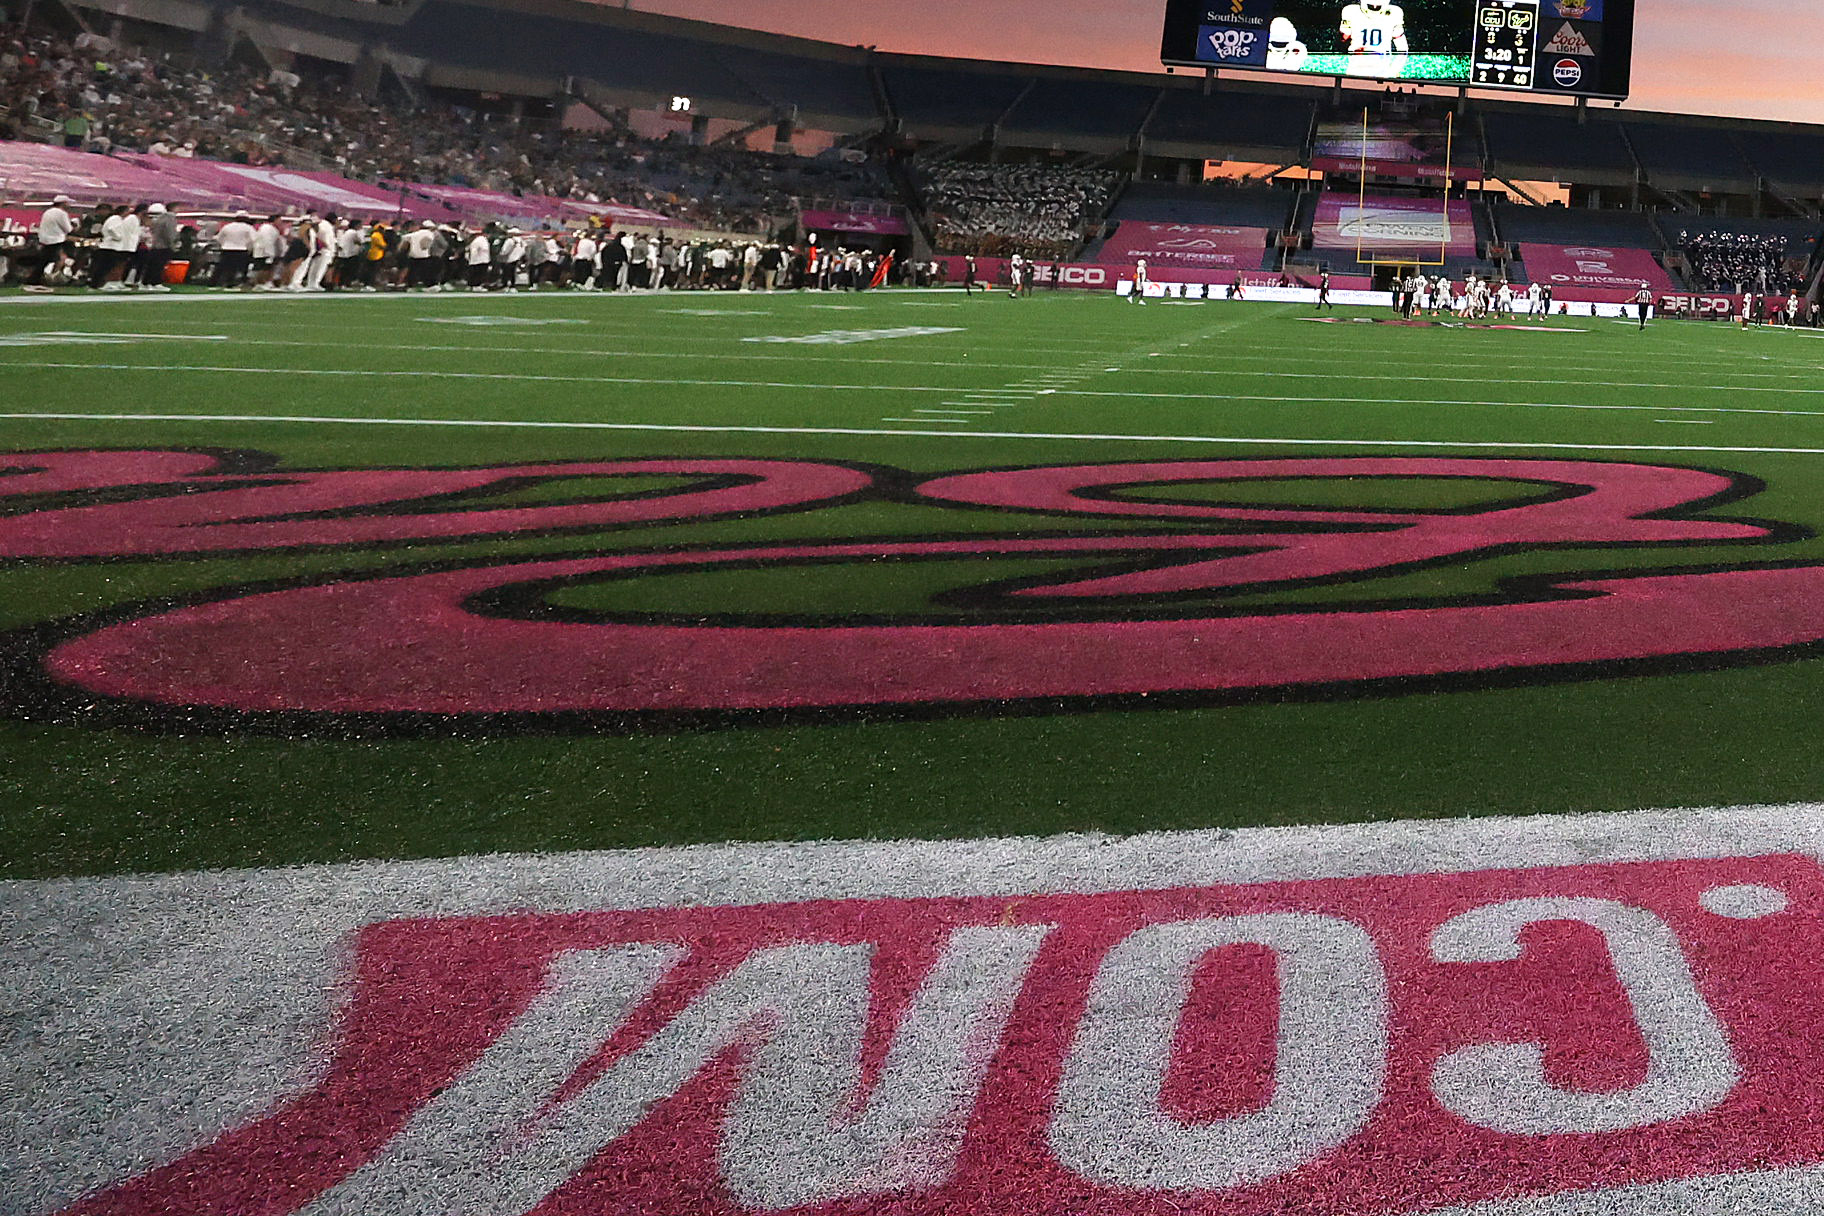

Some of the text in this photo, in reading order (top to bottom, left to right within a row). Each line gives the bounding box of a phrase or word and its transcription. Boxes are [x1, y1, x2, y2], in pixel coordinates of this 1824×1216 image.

[1207, 11, 1264, 25] SouthState
[1360, 28, 1382, 47] 10
[1552, 32, 1587, 46] Coors
[1556, 44, 1580, 53] LIGHT
[1555, 68, 1580, 77] PEPSI
[1032, 265, 1105, 284] GEICO
[1662, 295, 1729, 313] GEICO
